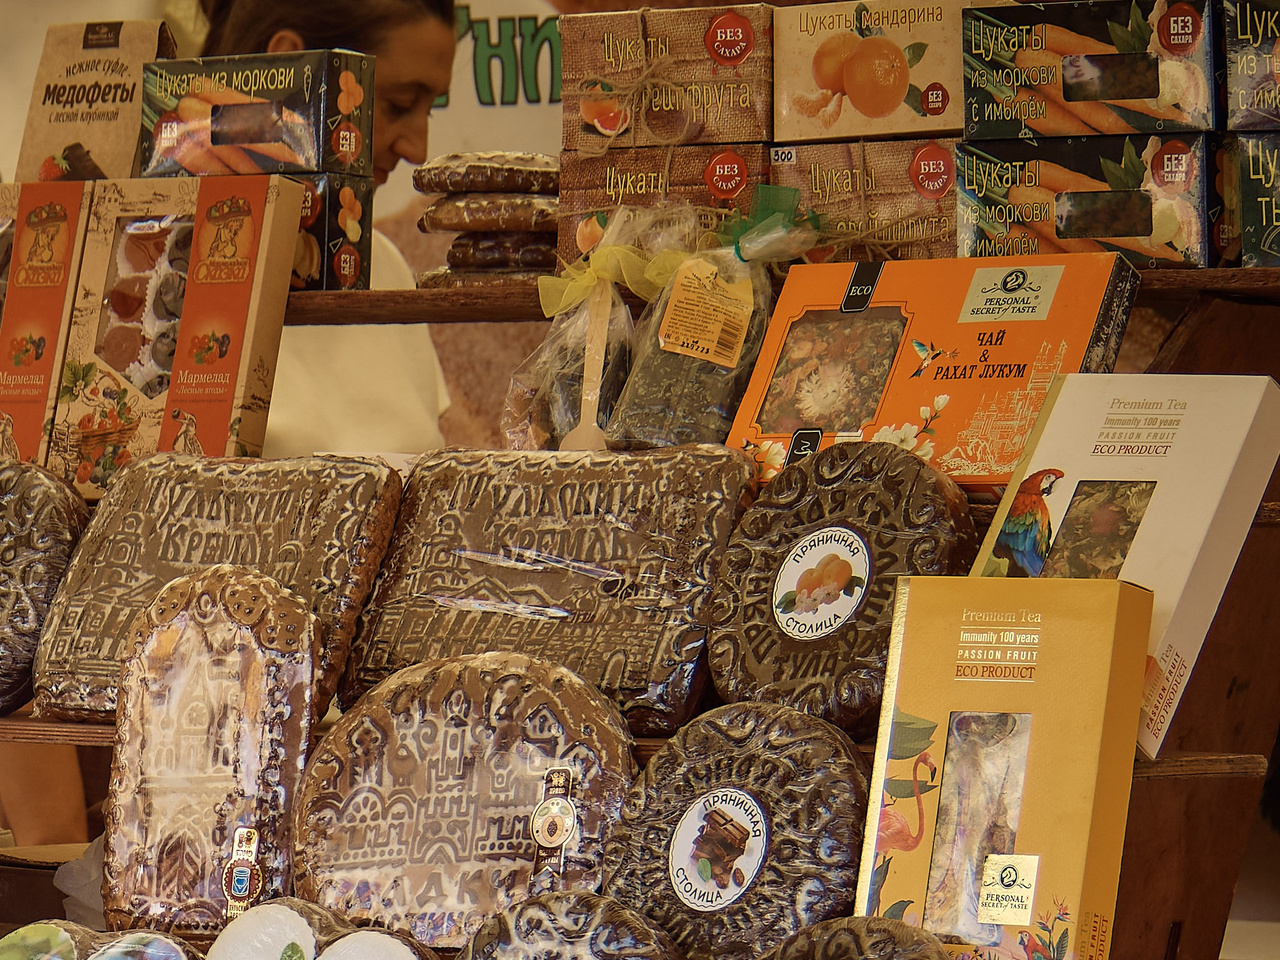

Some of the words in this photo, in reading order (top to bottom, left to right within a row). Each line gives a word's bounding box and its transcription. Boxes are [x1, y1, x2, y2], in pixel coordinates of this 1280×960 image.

[799, 11, 856, 37] Цукаты
[862, 6, 943, 33] мандарина
[1169, 16, 1193, 33] БЕЗ
[716, 27, 743, 41] БЕЗ
[970, 19, 1047, 55] Цукаты
[1169, 33, 1193, 45] САХАРА
[604, 32, 670, 72] Цукаты
[713, 41, 747, 57] САХАРА
[65, 58, 101, 78] нежное
[103, 57, 129, 77] суфле
[156, 69, 206, 101] Цукаты
[210, 71, 227, 91] из
[232, 67, 295, 102] моркови
[970, 68, 989, 87] из
[993, 64, 1057, 97] моркови
[928, 90, 943, 101] БЕЗ
[54, 110, 79, 123] лесной
[80, 108, 119, 125] клубникой
[983, 97, 1047, 128] имбирём
[161, 121, 178, 137] БЕЗ
[339, 131, 350, 152] БЕЗ
[715, 164, 739, 176] БЕЗ
[920, 160, 945, 173] БЕЗ
[1163, 154, 1186, 171] БЕЗ
[918, 174, 948, 190] САХАРА
[964, 155, 1040, 192] Цукаты
[1163, 172, 1186, 182] САХАРА
[606, 166, 670, 205] Цукаты
[712, 175, 741, 190] САХАРА
[811, 163, 876, 205] Цукаты
[963, 205, 981, 224] из
[985, 201, 1050, 233] моркови
[849, 285, 872, 297] ECO
[984, 296, 1032, 306] PERSONAL
[970, 306, 1003, 316] SECRET
[1009, 305, 1037, 315] TASTE
[976, 329, 1006, 347] ЧАЙ
[979, 352, 990, 363] &
[176, 370, 230, 387] Мармелад
[933, 364, 977, 381] РАХАТ
[977, 363, 1026, 380] ЛУКУМ
[1110, 398, 1163, 411] Premium
[1166, 399, 1187, 411] Tea
[1104, 416, 1141, 428] Immunity
[1143, 416, 1158, 427] 100
[1159, 417, 1181, 428] years
[1098, 432, 1143, 440] PASSION
[1147, 431, 1177, 440] FRUIT
[1091, 445, 1116, 455] ECO
[1117, 444, 1171, 455] PRODUCT
[792, 534, 860, 564] ПРЯНИЧНАЯ
[785, 613, 841, 635] СТОЛИЦА
[962, 608, 1016, 623] Premium
[1019, 609, 1042, 623] Tea
[959, 631, 998, 644] Immunity
[999, 631, 1014, 643] 100
[1016, 633, 1039, 645] years
[957, 649, 1002, 661] PASSION
[1006, 650, 1038, 661] FRUIT
[1160, 643, 1174, 664] Tea
[955, 665, 978, 678] ECO
[980, 665, 1036, 680] PRODUCT
[1145, 685, 1167, 730] PASSION
[1166, 651, 1181, 683] FRUIT
[1152, 714, 1166, 740] ECO
[1163, 660, 1188, 715] PRODUCT
[702, 795, 761, 838] ПРЯНИЧНАЯ
[675, 866, 723, 904] СТОЛИЦА
[985, 893, 1025, 903] PERSONAL
[1080, 911, 1091, 935] Tea
[1090, 912, 1100, 948] FRUIT
